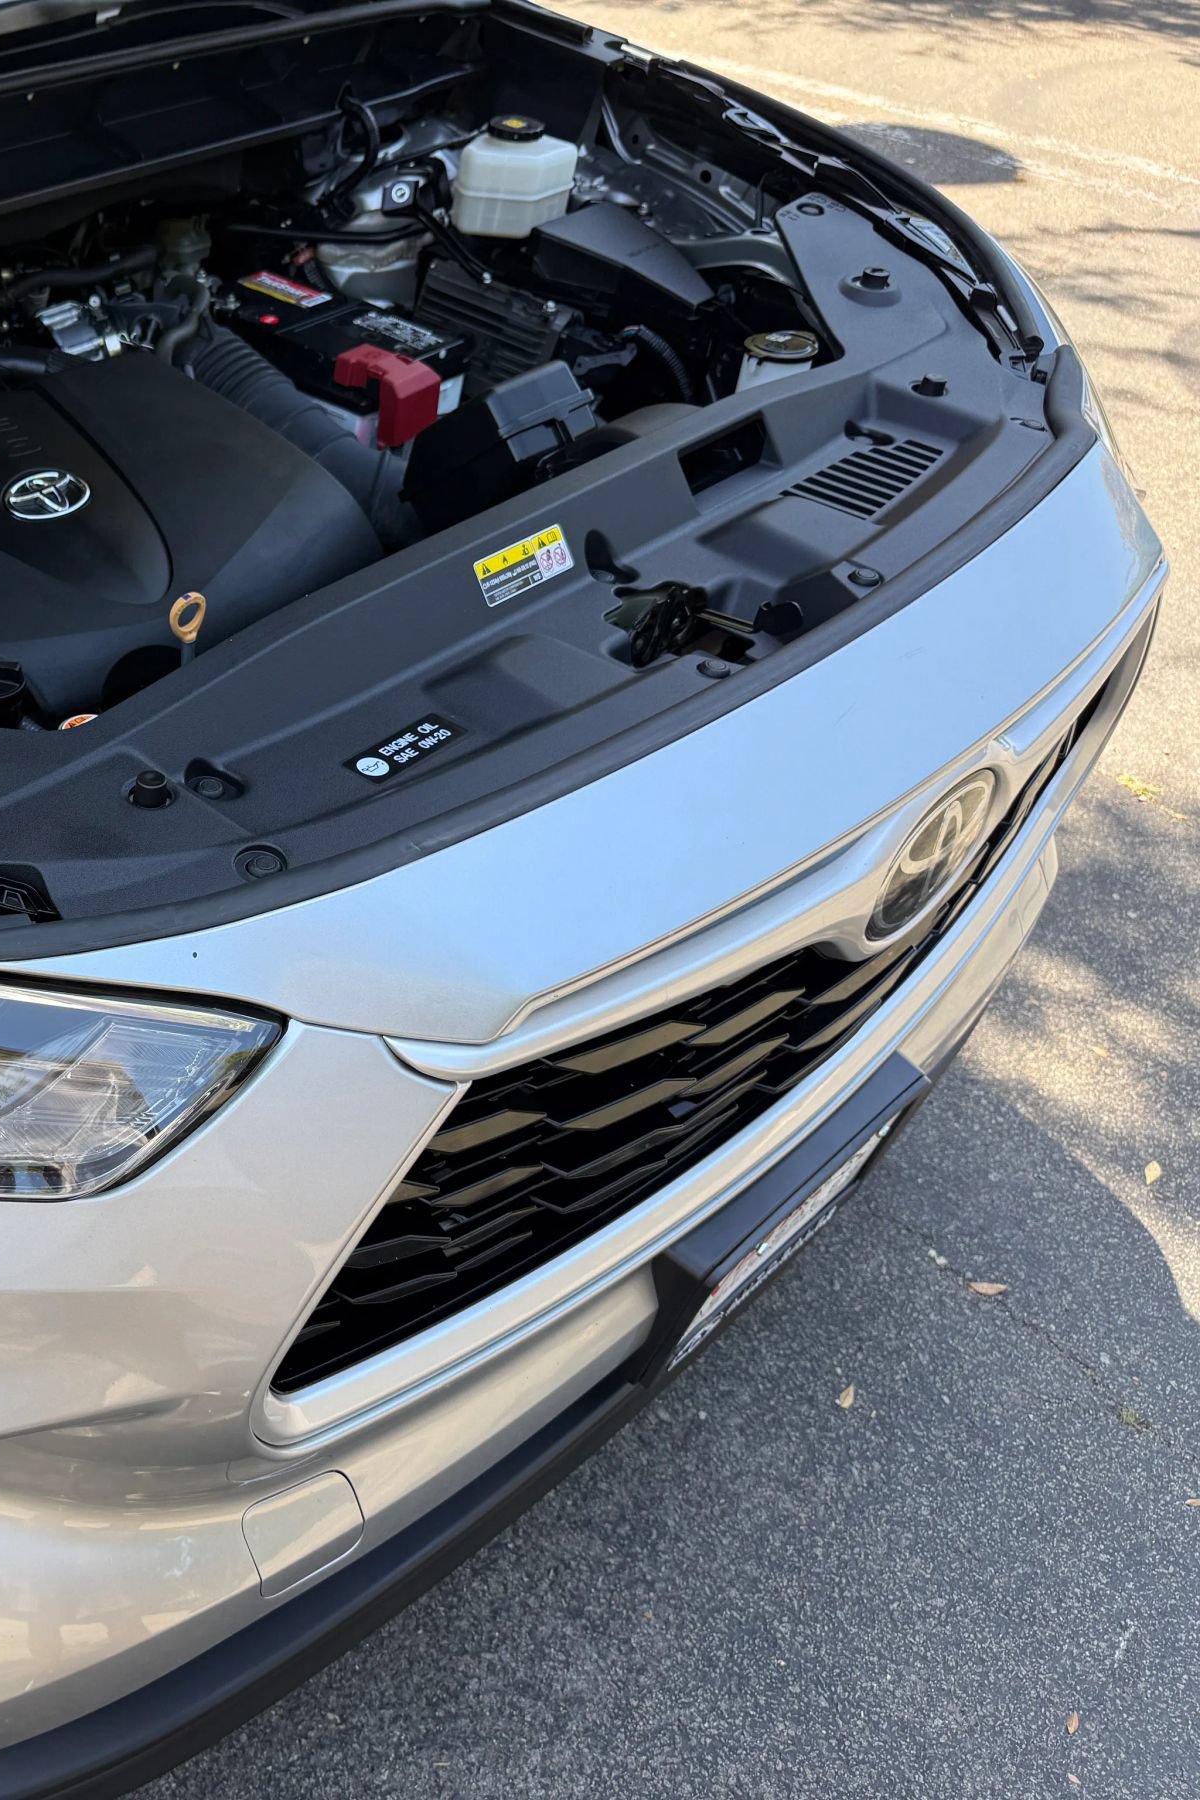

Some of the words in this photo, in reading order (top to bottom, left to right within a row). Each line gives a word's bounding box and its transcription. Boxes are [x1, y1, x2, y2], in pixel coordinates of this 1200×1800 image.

[378, 732, 419, 756] ENGINE
[417, 722, 439, 734] OIL
[393, 747, 419, 763] SAE
[417, 729, 452, 749] 0W-20
